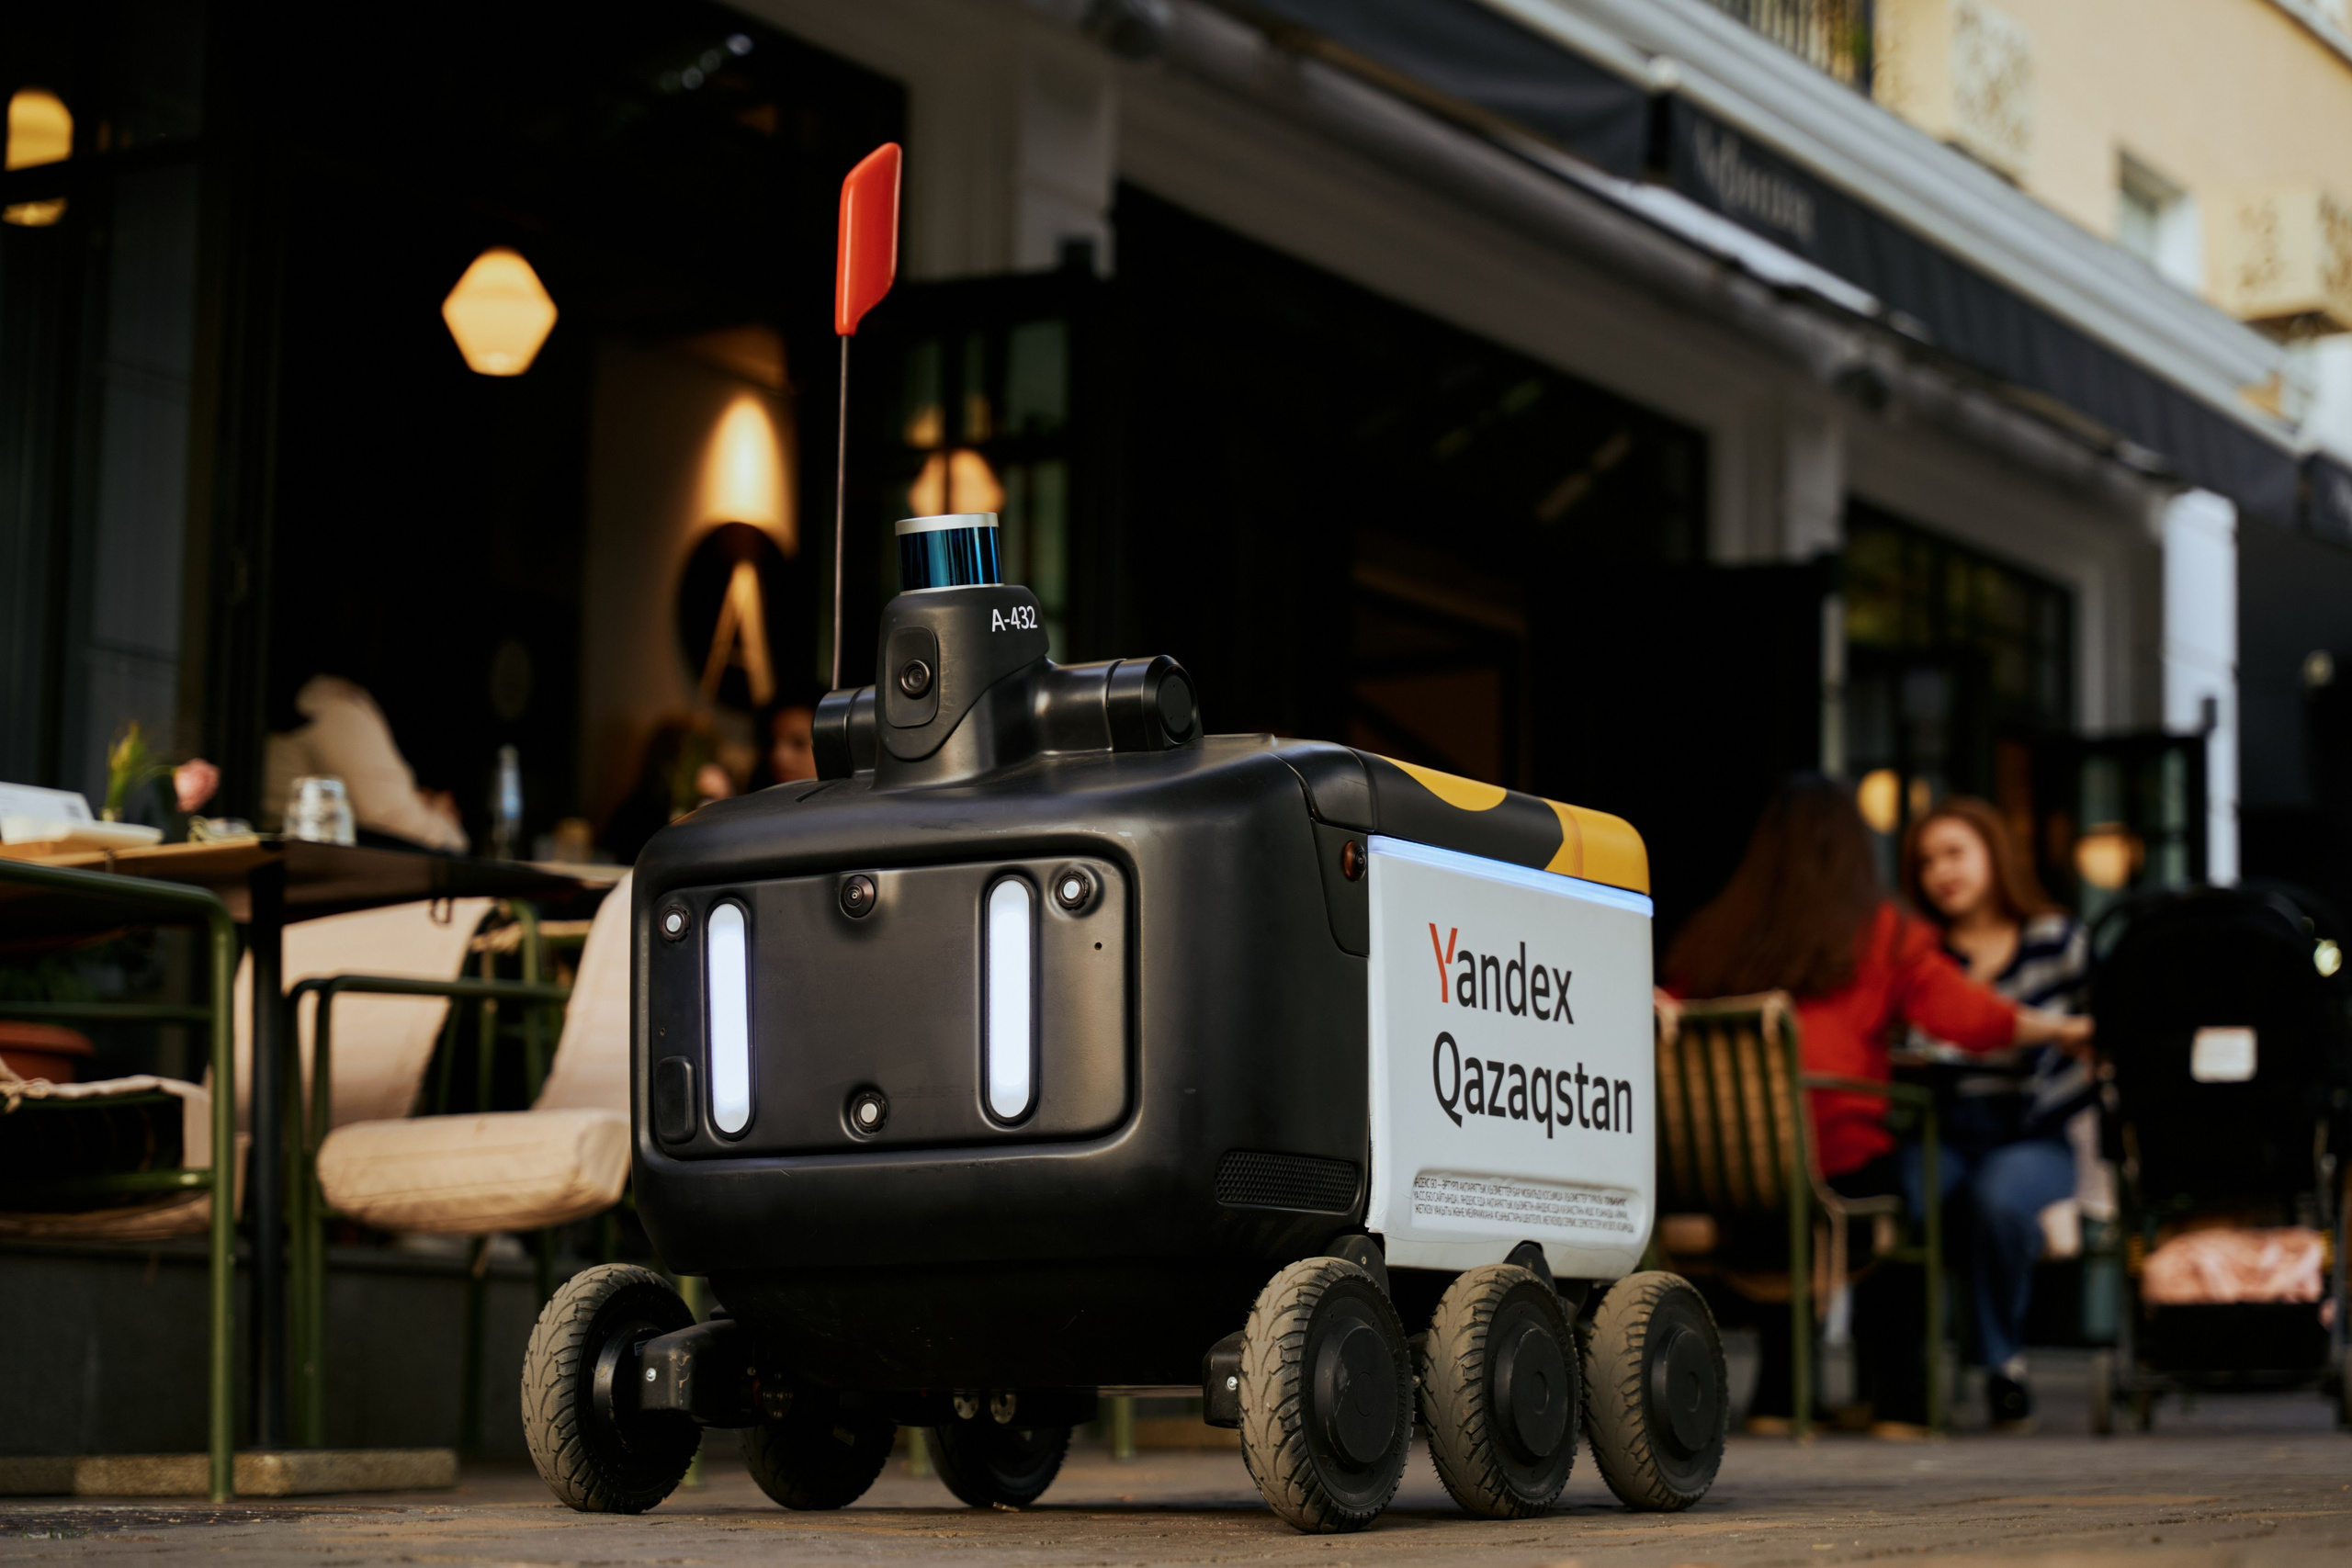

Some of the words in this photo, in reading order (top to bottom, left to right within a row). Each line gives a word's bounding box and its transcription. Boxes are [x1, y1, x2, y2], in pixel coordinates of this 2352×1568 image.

[992, 605, 1038, 632] A-432
[1429, 922, 1574, 1024] Yandex
[1432, 1031, 1633, 1139] Qazaqstan
